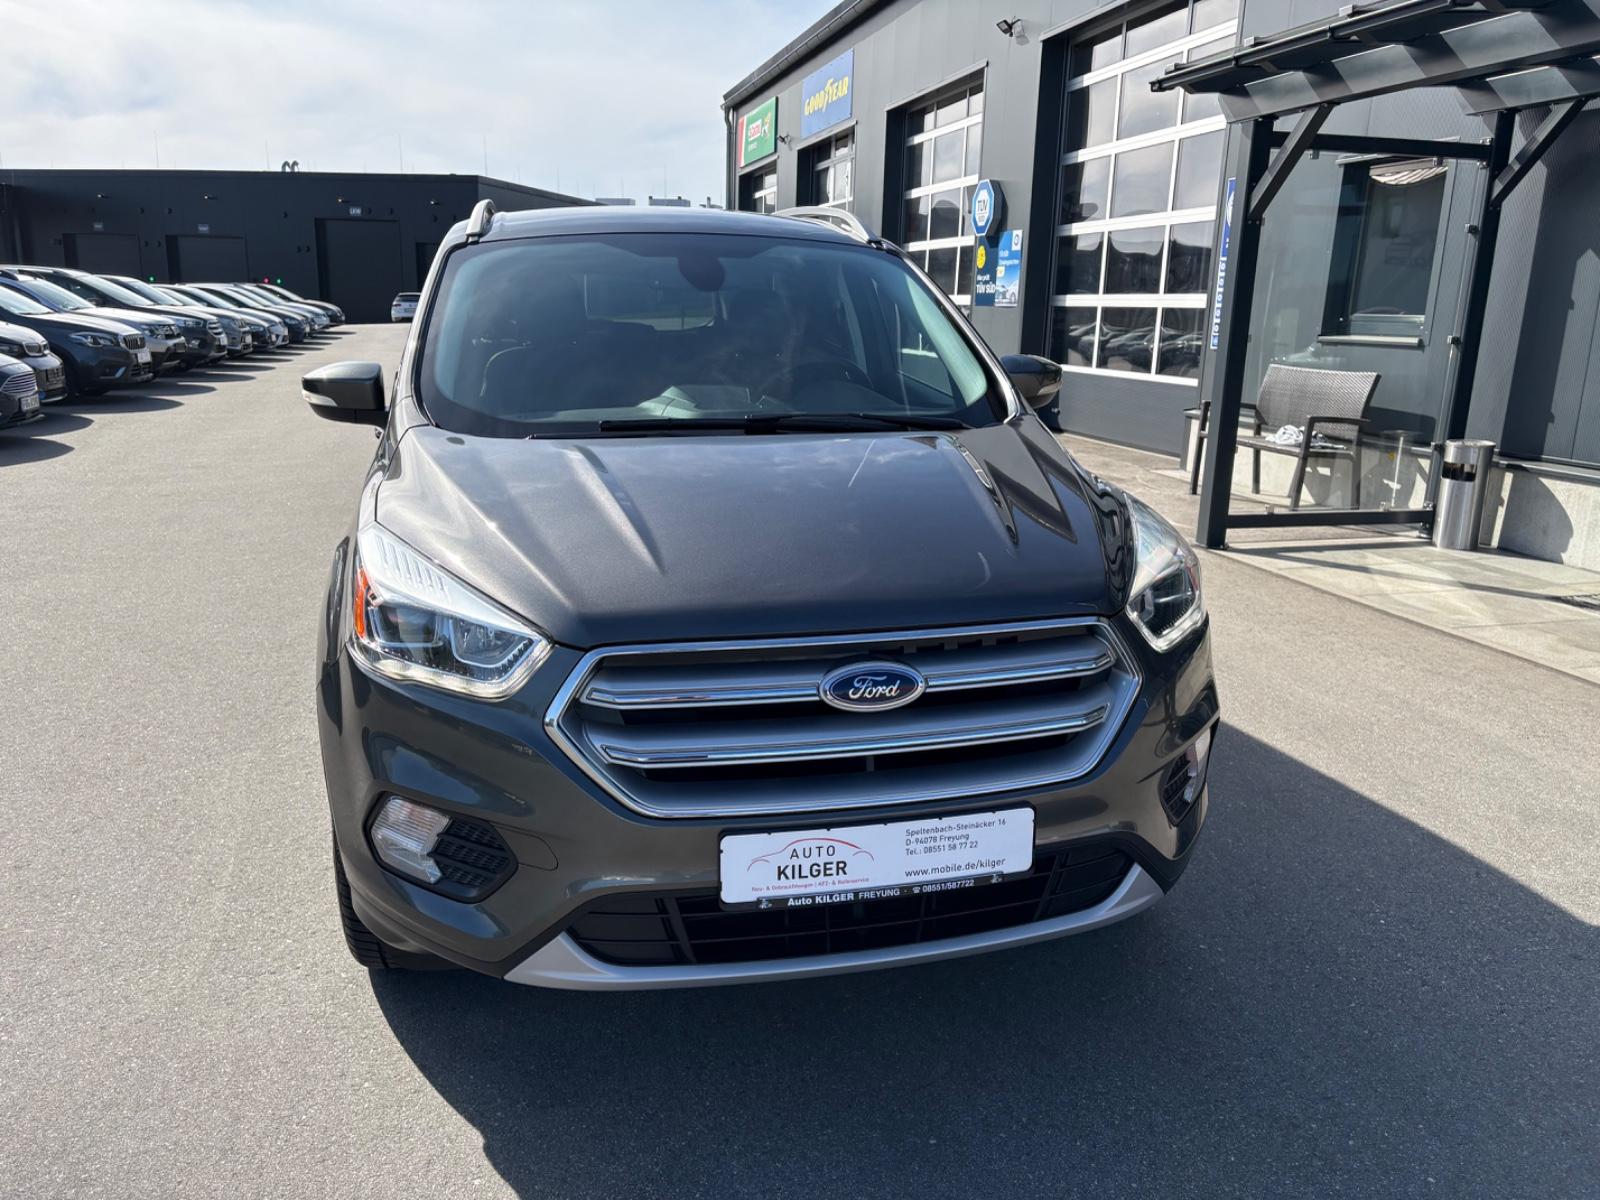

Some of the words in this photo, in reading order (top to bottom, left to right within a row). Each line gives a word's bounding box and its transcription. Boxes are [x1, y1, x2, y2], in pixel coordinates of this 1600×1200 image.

[804, 76, 849, 116] GOODYEAR
[976, 281, 985, 293] TÜV
[986, 281, 996, 293] SÜD
[849, 676, 900, 699] Ford
[998, 818, 1007, 826] 16
[905, 837, 938, 847] D-94078
[939, 833, 970, 843] Freyung
[923, 845, 946, 855] 08551
[947, 844, 957, 852] 58
[959, 843, 968, 851] 77
[969, 841, 979, 849] 22
[790, 845, 836, 860] AUTO
[777, 861, 848, 881] KILGER
[905, 858, 1006, 877] www.mobile.de/kilger
[787, 898, 812, 906] Auto
[815, 893, 855, 904] KILGER
[858, 889, 901, 900] FREYUNG
[922, 879, 975, 893] 08551/587722
